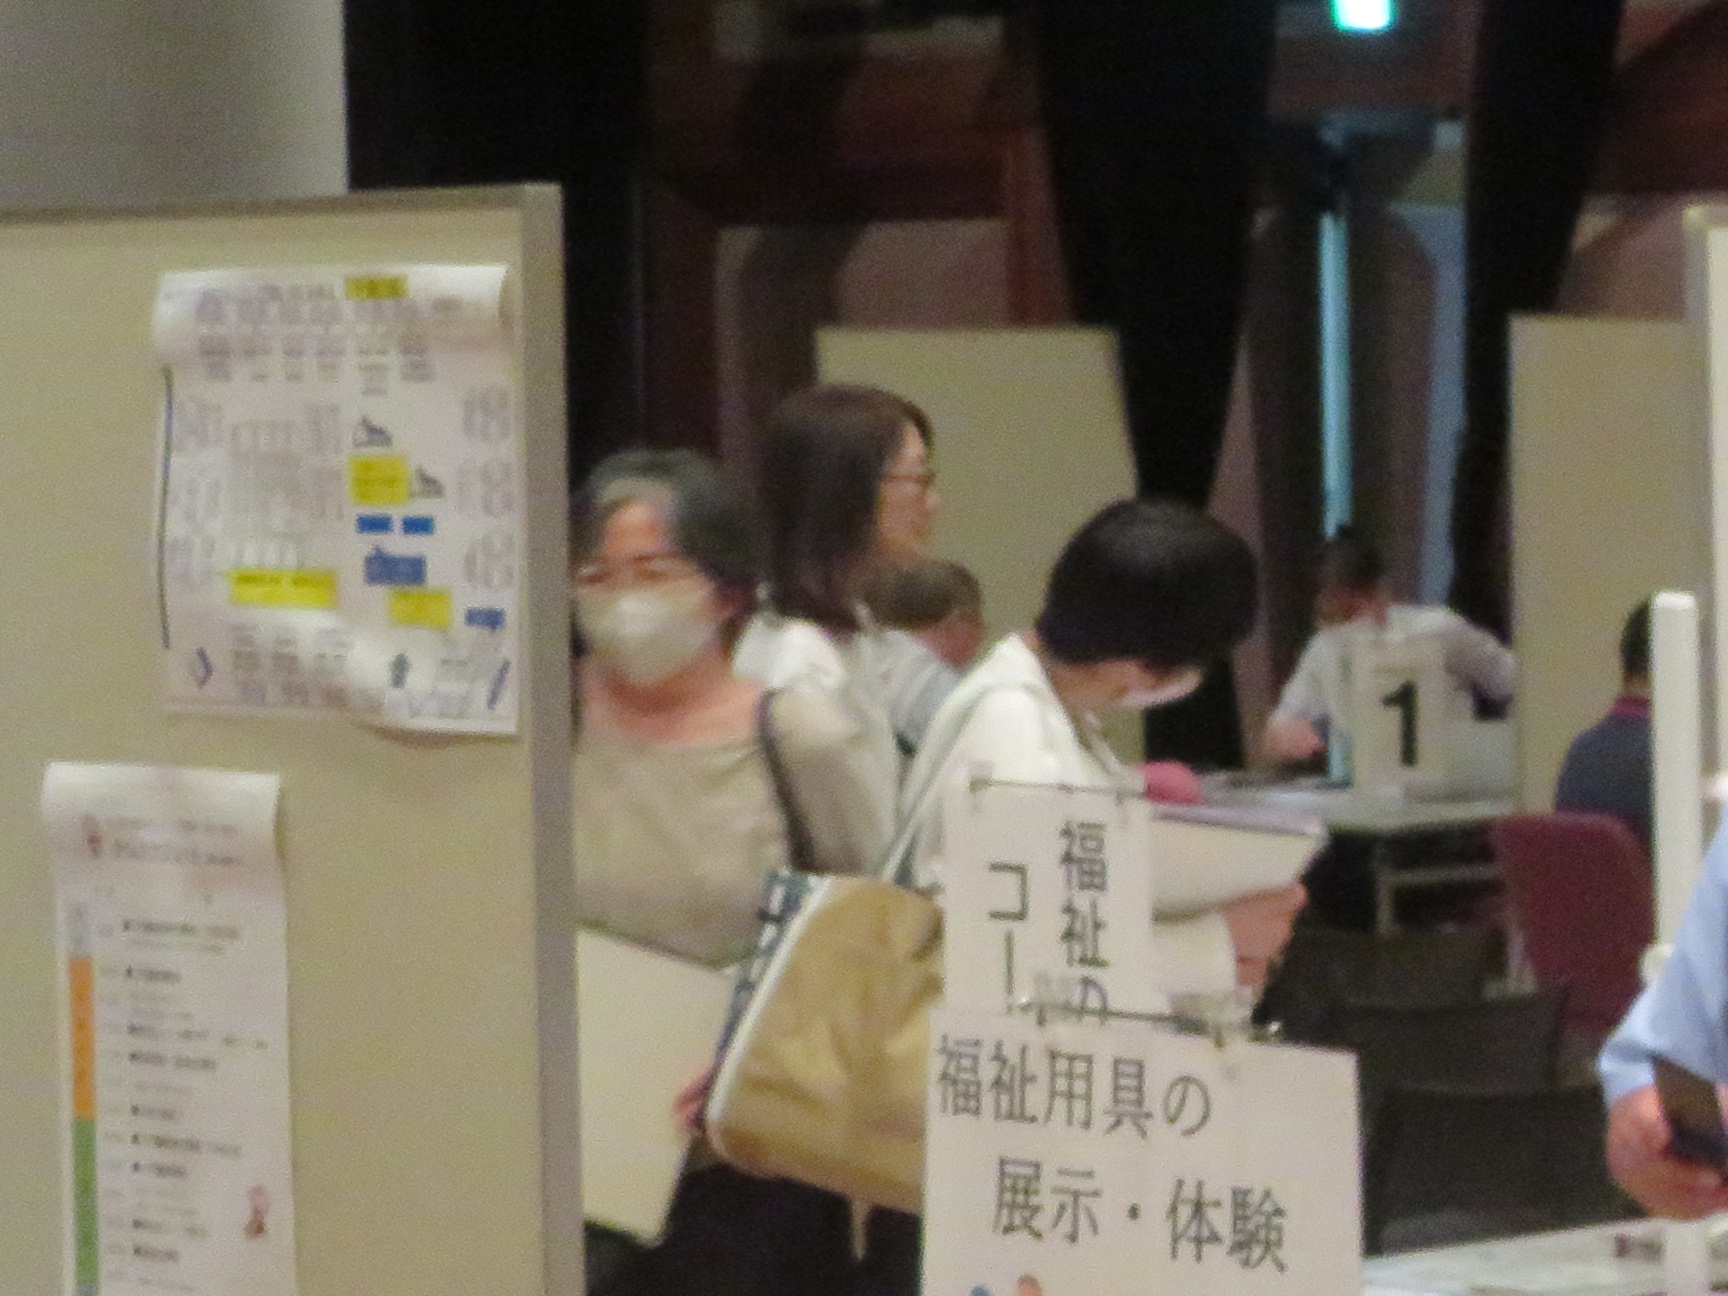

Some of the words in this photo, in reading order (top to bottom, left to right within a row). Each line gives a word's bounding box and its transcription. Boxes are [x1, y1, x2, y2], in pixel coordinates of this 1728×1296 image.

[1381, 679, 1418, 768] 1
[937, 1034, 1213, 1139] 福祉用具の
[991, 1155, 1288, 1274] 展示・体験
